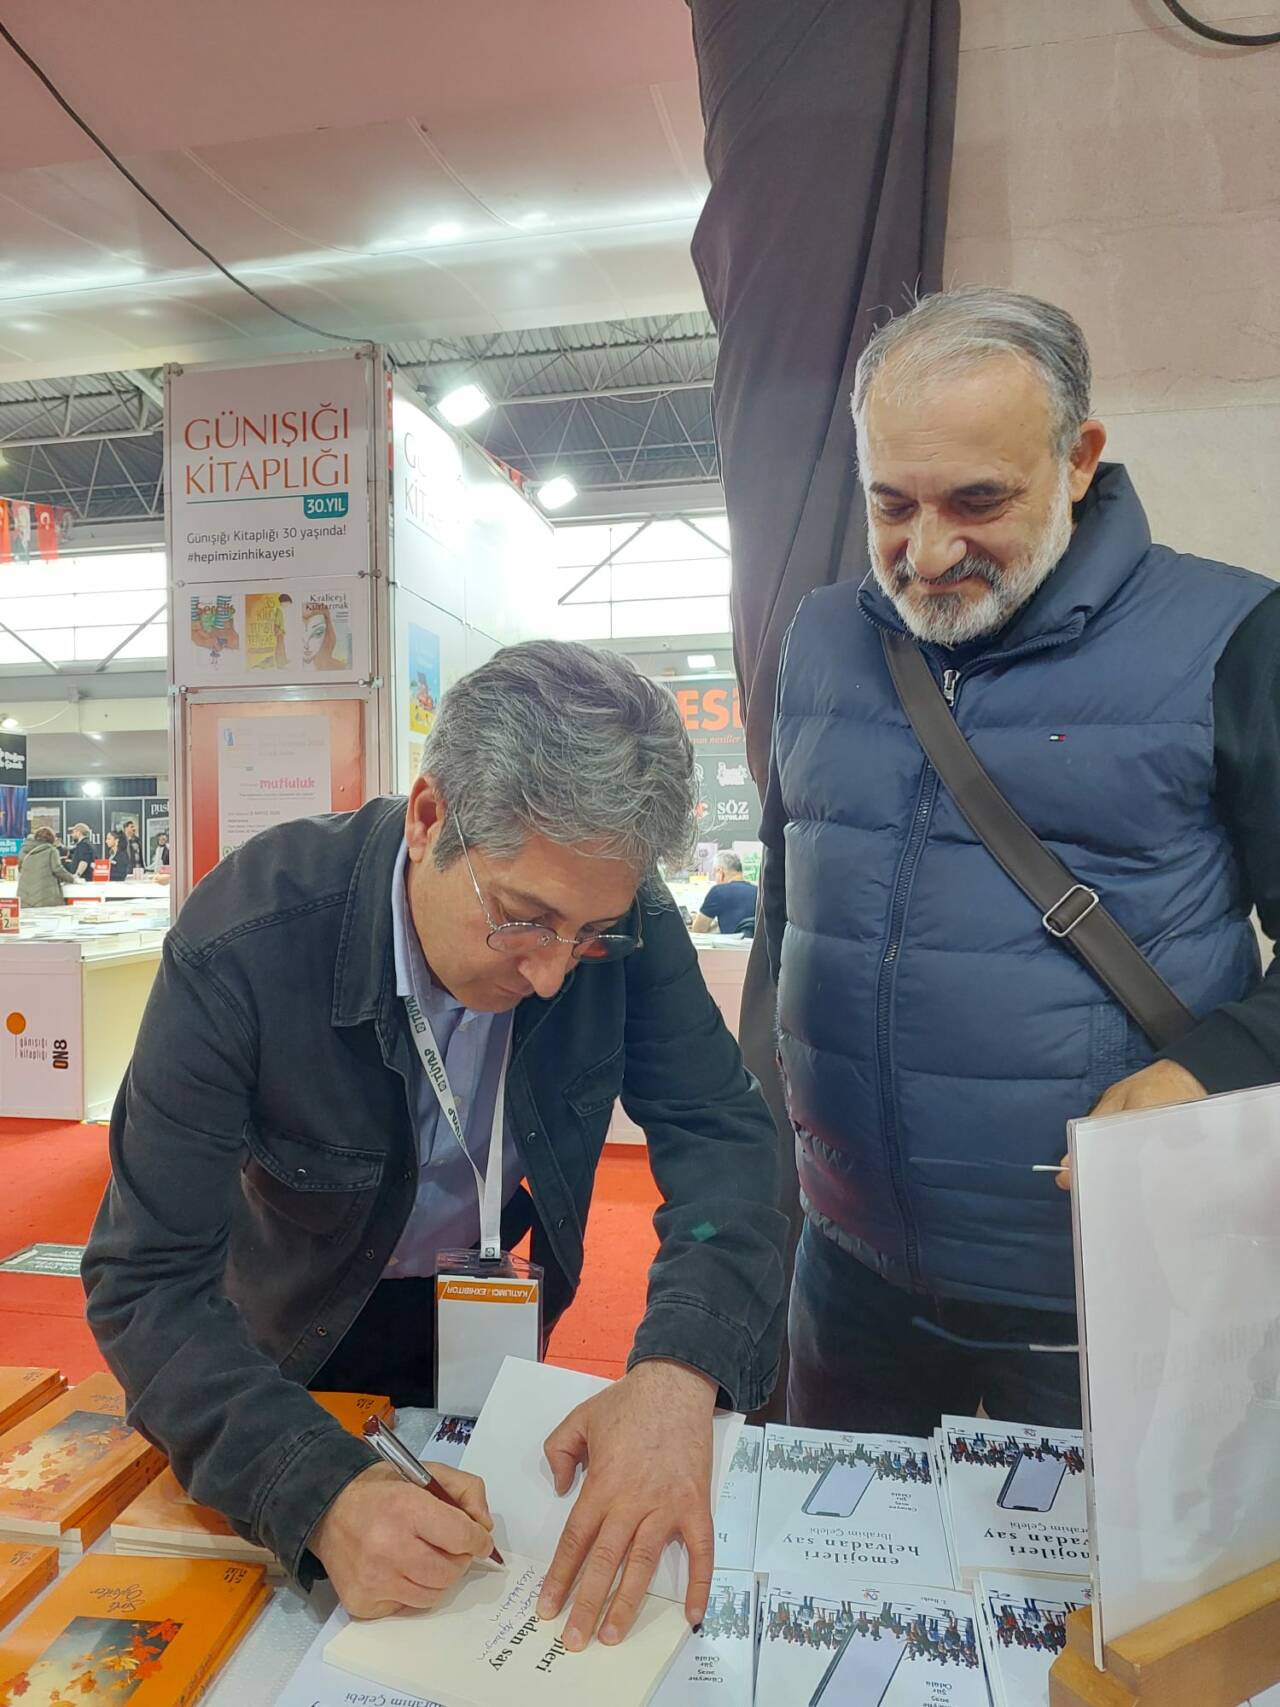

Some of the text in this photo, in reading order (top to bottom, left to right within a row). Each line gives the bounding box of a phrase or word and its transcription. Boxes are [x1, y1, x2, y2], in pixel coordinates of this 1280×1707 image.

[184, 402, 348, 451] GÜNIŞIĞI
[186, 448, 348, 494] KİTAPLIĞI
[306, 498, 346, 514] 30.YIL
[233, 528, 279, 543] Kitaplığı
[282, 527, 297, 538] 30
[300, 525, 346, 540] yaşında!
[187, 547, 295, 564] #hepimizinhikayesi
[260, 777, 315, 789] mutluluk
[717, 799, 749, 815] SÖZ
[424, 1048, 444, 1081] TÜYAP
[783, 1533, 920, 1556] helvadan say
[984, 1527, 1089, 1547] vadan say
[804, 1550, 899, 1565] emojileri
[510, 1615, 541, 1645] adan
[488, 1648, 513, 1671] say
[535, 1636, 569, 1673] jileri
